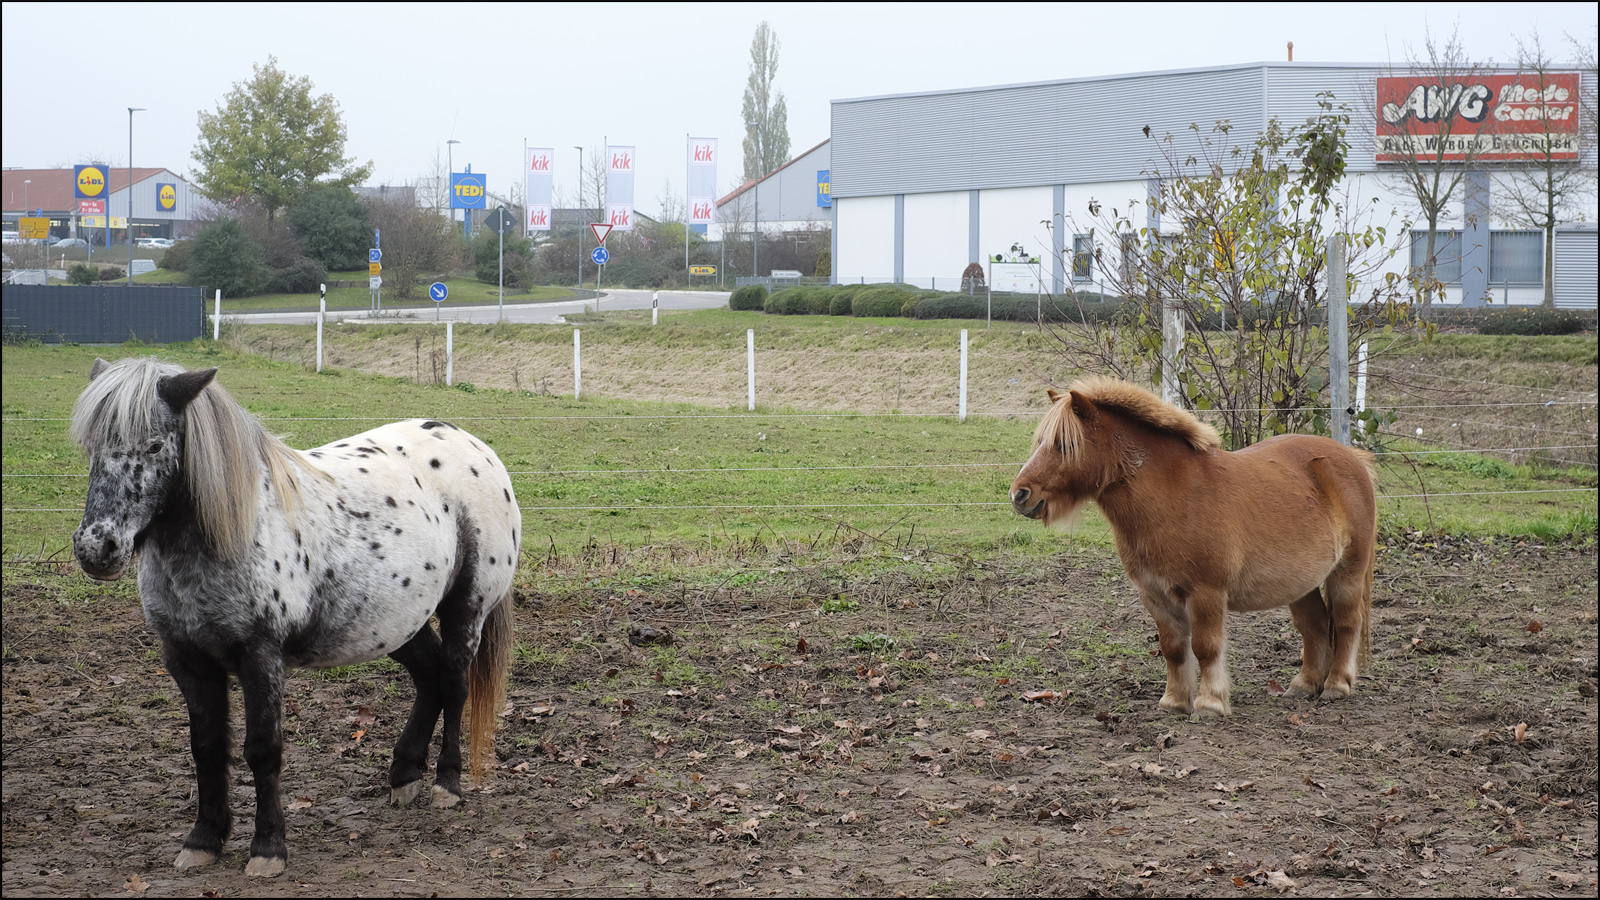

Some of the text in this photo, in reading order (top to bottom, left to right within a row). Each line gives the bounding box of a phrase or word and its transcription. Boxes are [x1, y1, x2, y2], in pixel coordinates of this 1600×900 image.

[1498, 84, 1569, 102] Mode
[1382, 83, 1492, 123] AWG
[1494, 103, 1574, 121] Center
[454, 185, 484, 197] TEDi
